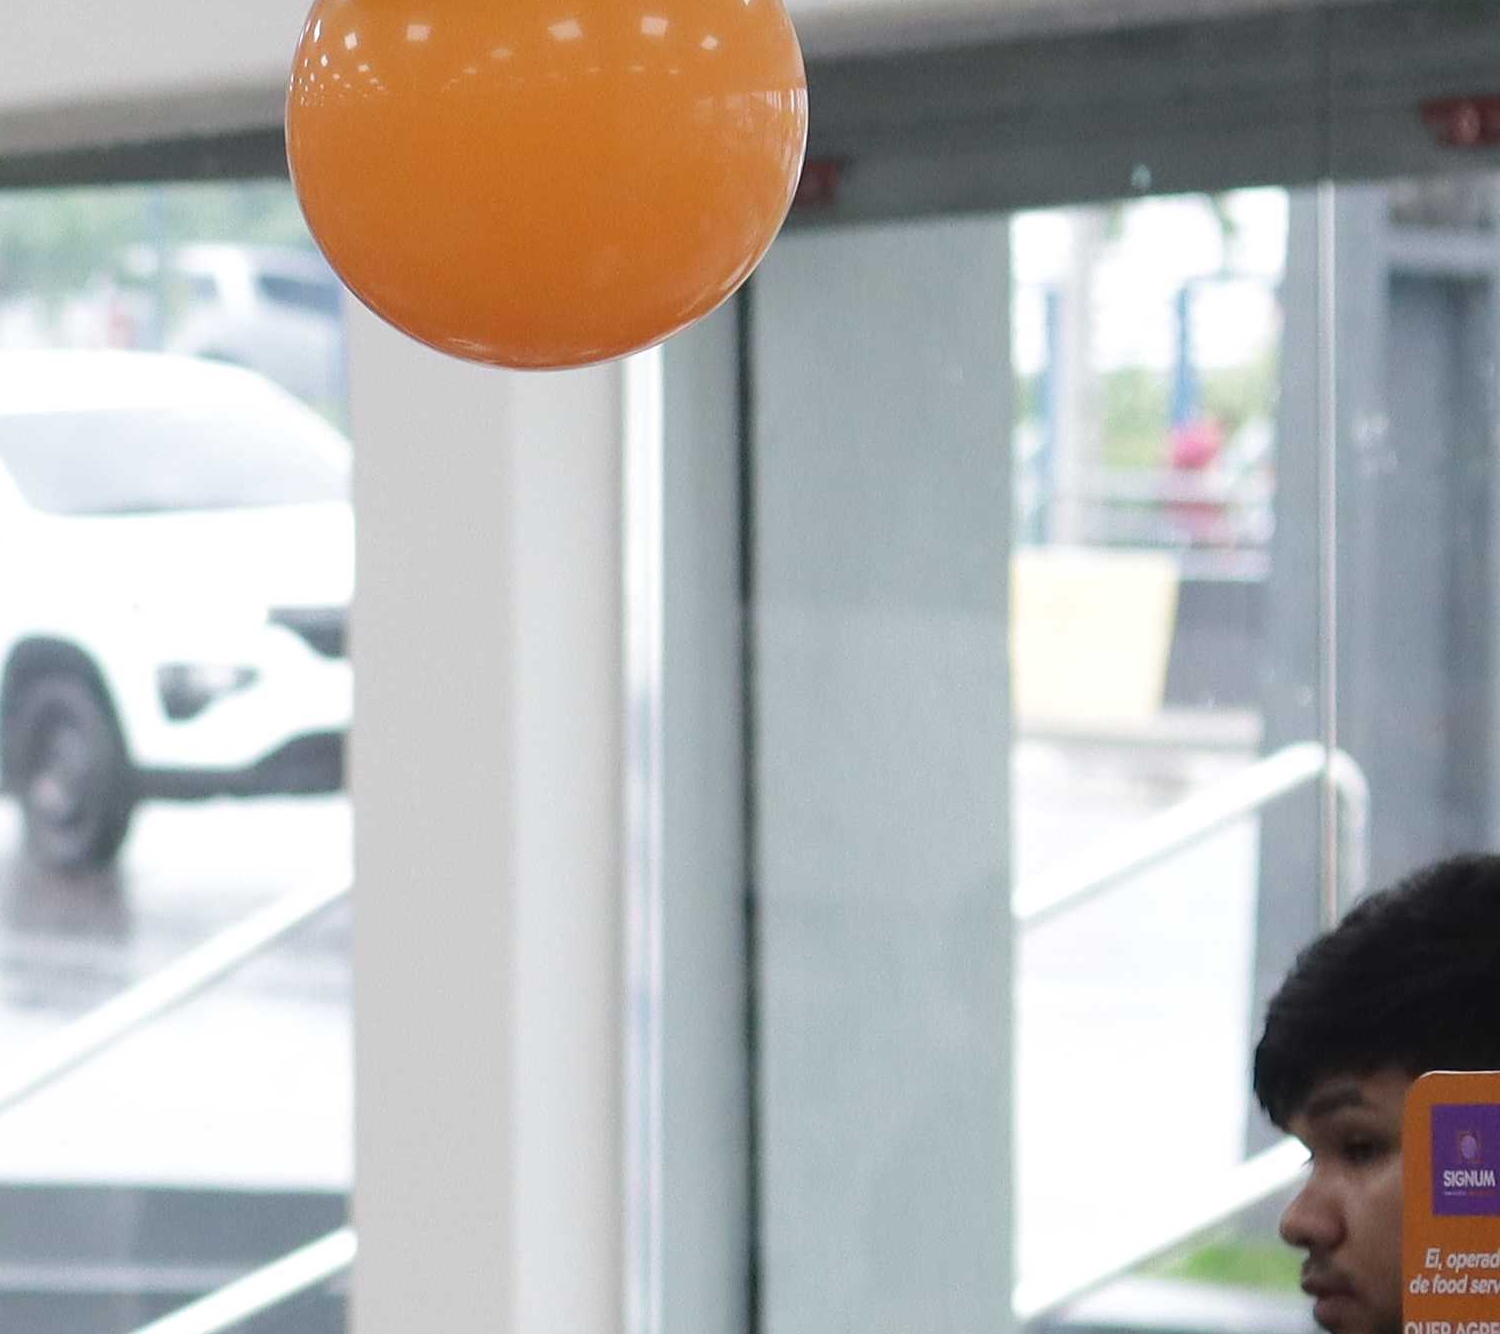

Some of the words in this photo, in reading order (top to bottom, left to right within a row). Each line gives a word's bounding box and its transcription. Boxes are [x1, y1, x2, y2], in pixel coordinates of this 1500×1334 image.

[1443, 1170, 1495, 1188] SIGNUM
[1424, 1247, 1443, 1270] Ei,
[1409, 1274, 1430, 1294] de
[1432, 1273, 1468, 1294] food
